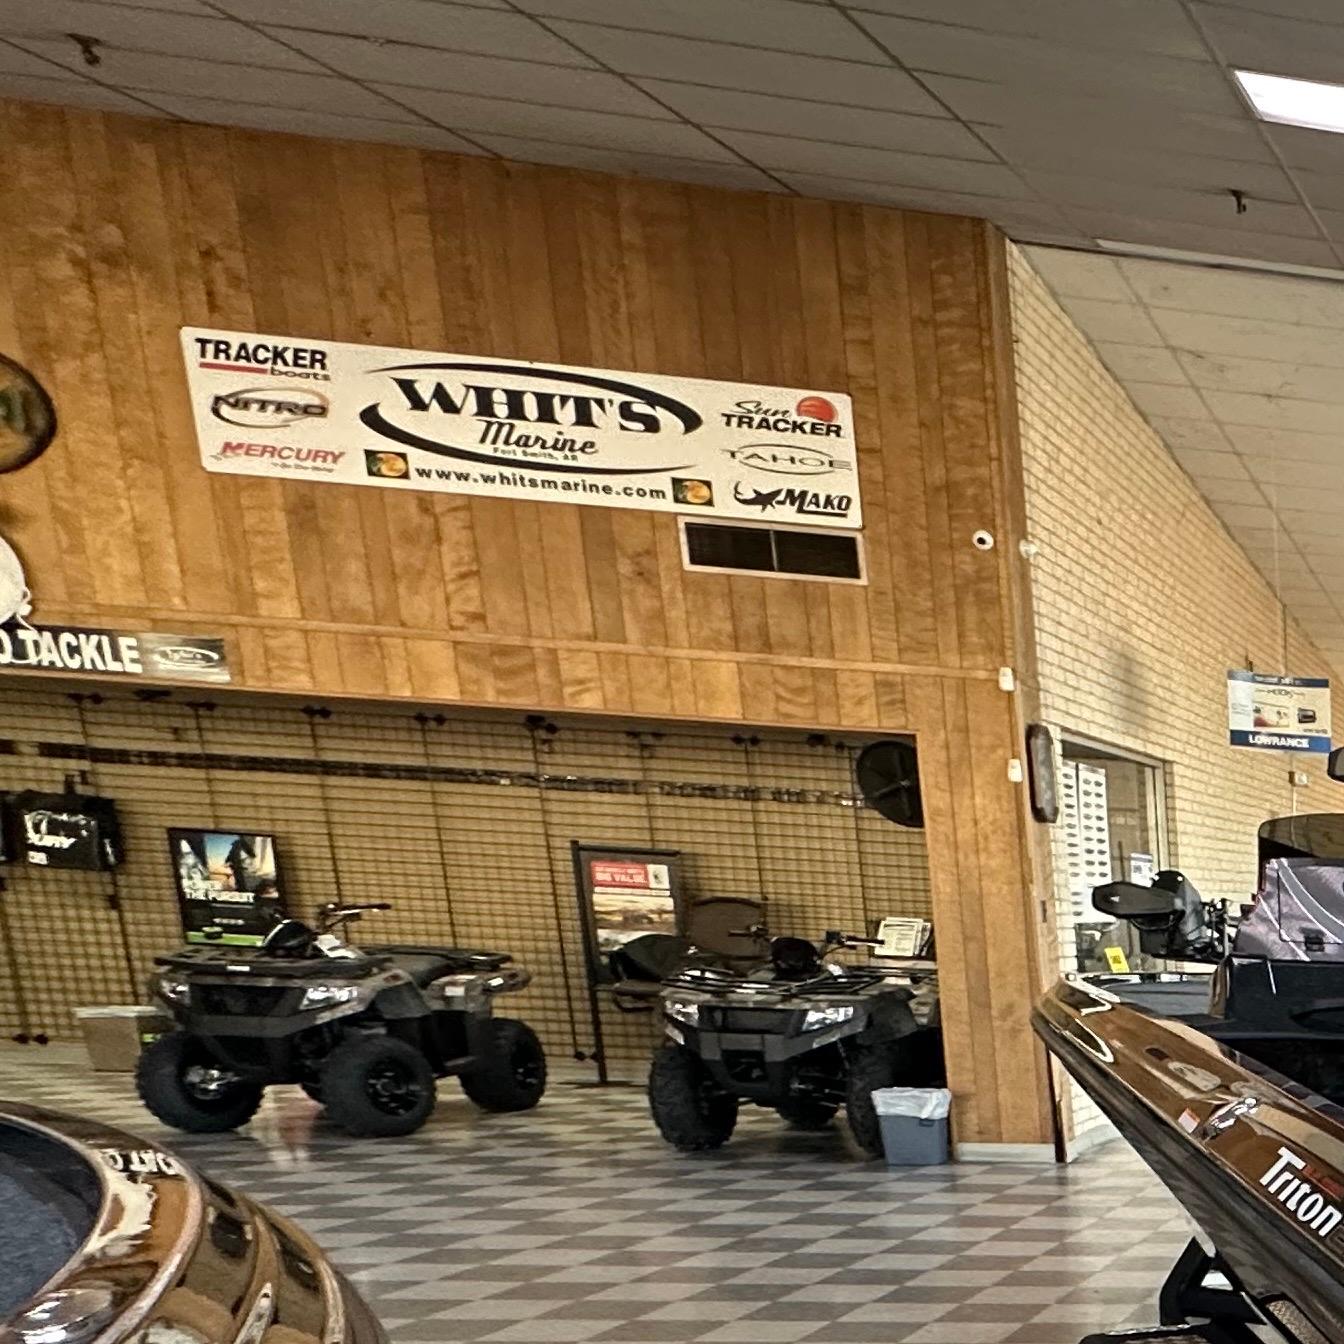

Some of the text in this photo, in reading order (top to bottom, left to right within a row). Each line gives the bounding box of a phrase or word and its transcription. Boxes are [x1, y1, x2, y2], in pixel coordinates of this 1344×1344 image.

[195, 337, 327, 371] TRACKER
[270, 366, 331, 382] boats
[389, 376, 662, 435] WHIT'S
[731, 400, 791, 417] Sun
[477, 418, 599, 456] Marine
[721, 412, 843, 438] TRACKER
[221, 441, 346, 464] MERCURY
[720, 448, 853, 472] TAHOE
[414, 466, 667, 500] www.whitsmarine.com
[775, 488, 853, 517] MAKO
[17, 629, 143, 673] TACKLE
[1248, 733, 1310, 749] LOWRANCE
[1258, 1146, 1344, 1237] Triton
